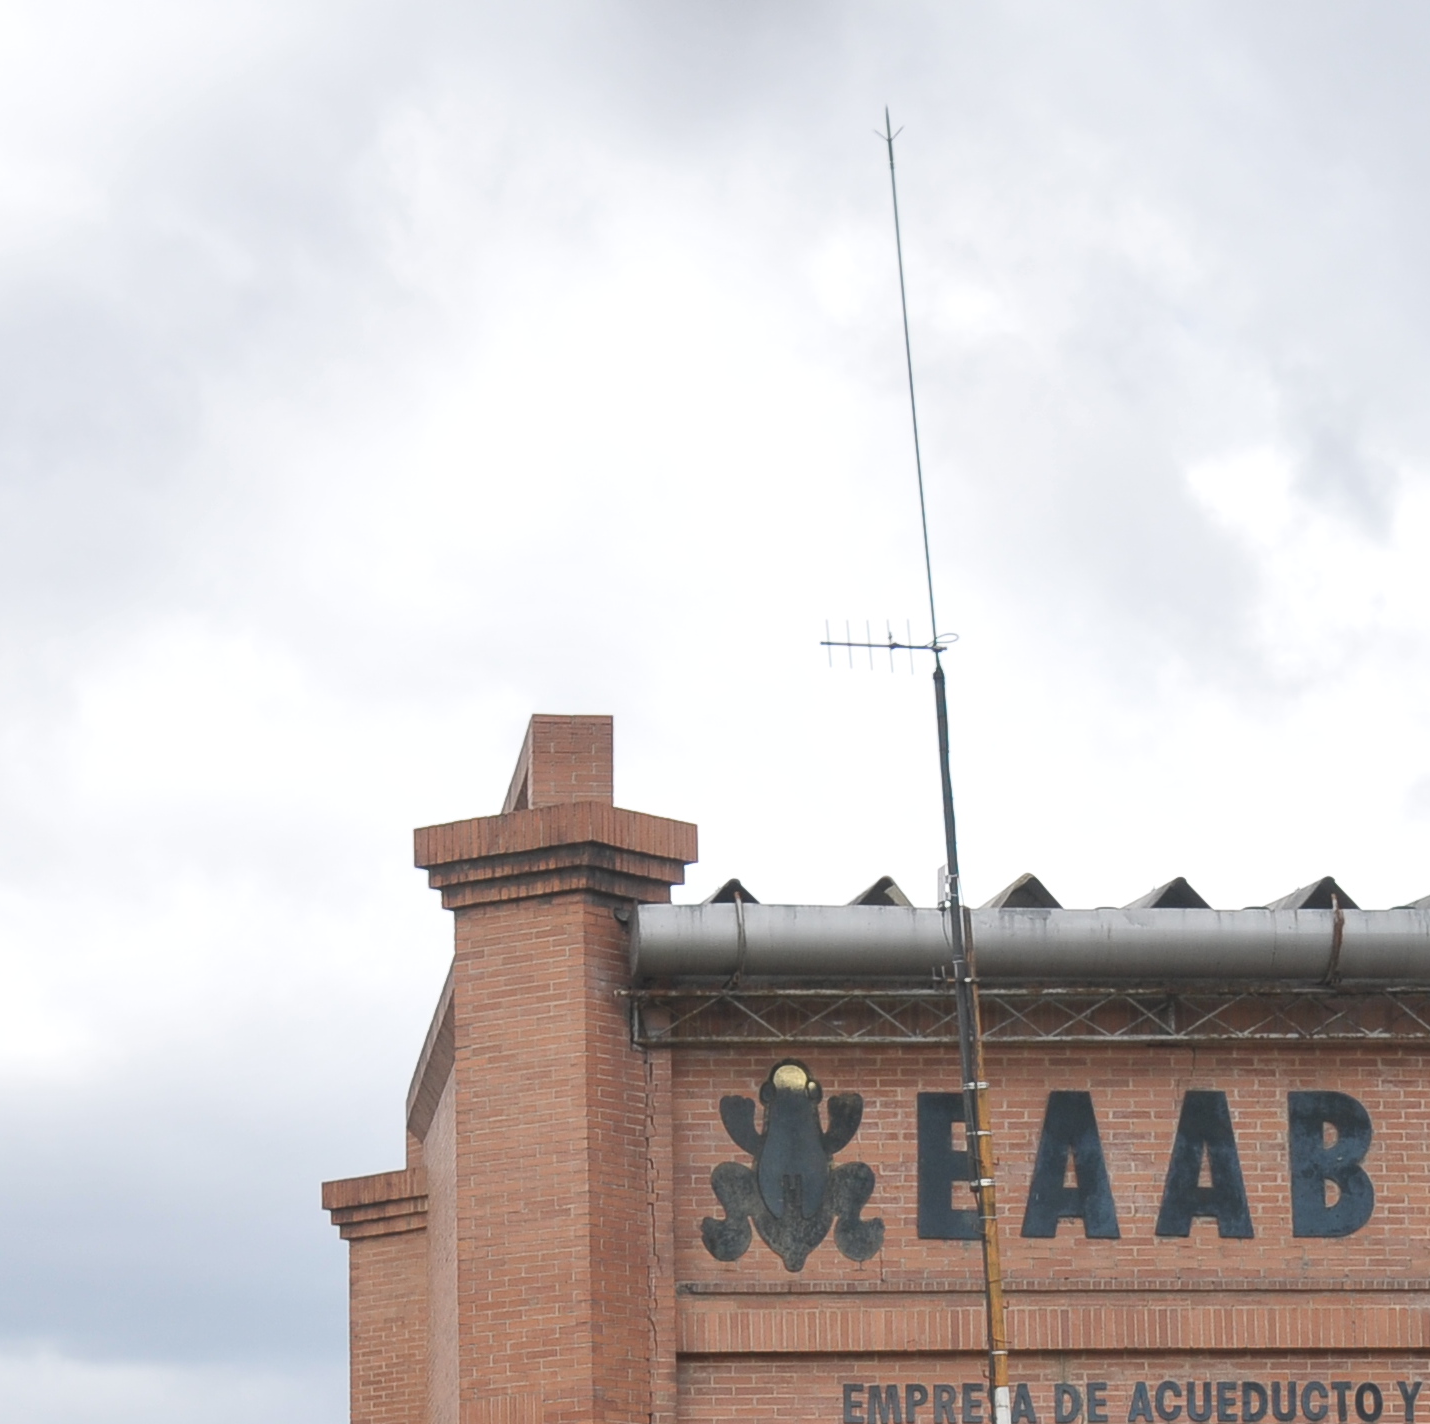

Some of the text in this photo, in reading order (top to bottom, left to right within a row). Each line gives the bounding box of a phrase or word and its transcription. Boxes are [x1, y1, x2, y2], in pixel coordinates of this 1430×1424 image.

[917, 1090, 1375, 1239] EAAB
[1054, 1381, 1109, 1424] DE
[1127, 1380, 1384, 1423] ACUEDUCTO
[1396, 1380, 1423, 1423] Y
